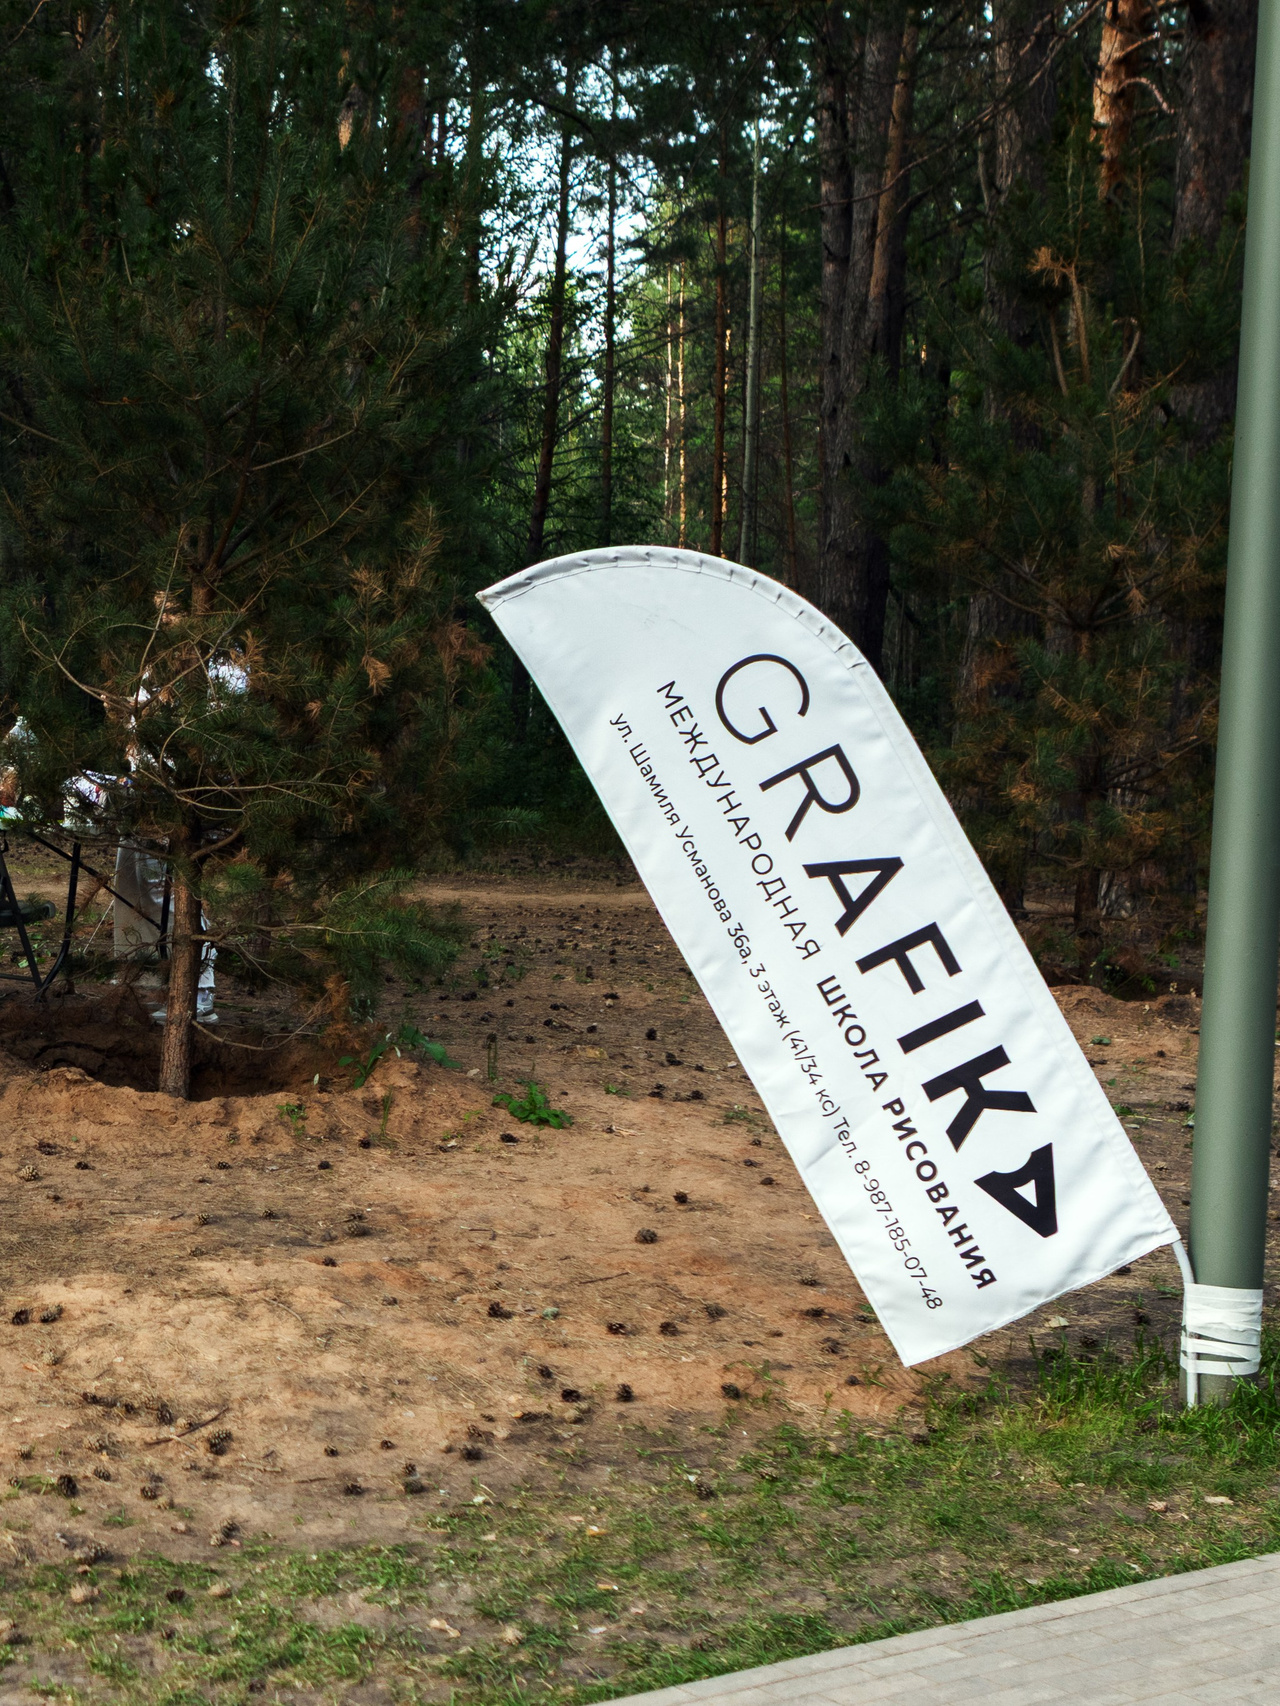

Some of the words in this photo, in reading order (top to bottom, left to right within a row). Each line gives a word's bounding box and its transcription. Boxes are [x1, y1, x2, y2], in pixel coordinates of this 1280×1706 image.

[609, 713, 632, 743] ул.
[629, 743, 680, 825] Шамиля
[676, 826, 732, 922] Усманова
[727, 922, 752, 964] 36а,
[656, 680, 821, 960] МЕЖДУНАРОДНАЯ
[816, 975, 888, 1092] ШКОЛА
[882, 1097, 997, 1289] РИСОВАНИЯ
[749, 963, 766, 978] 3
[757, 981, 790, 1028] этаж
[782, 1030, 822, 1085] (41/34
[815, 1089, 841, 1117] кс)
[833, 1117, 857, 1158] Тел.
[854, 1160, 943, 1309] 8-987-185-07-48
